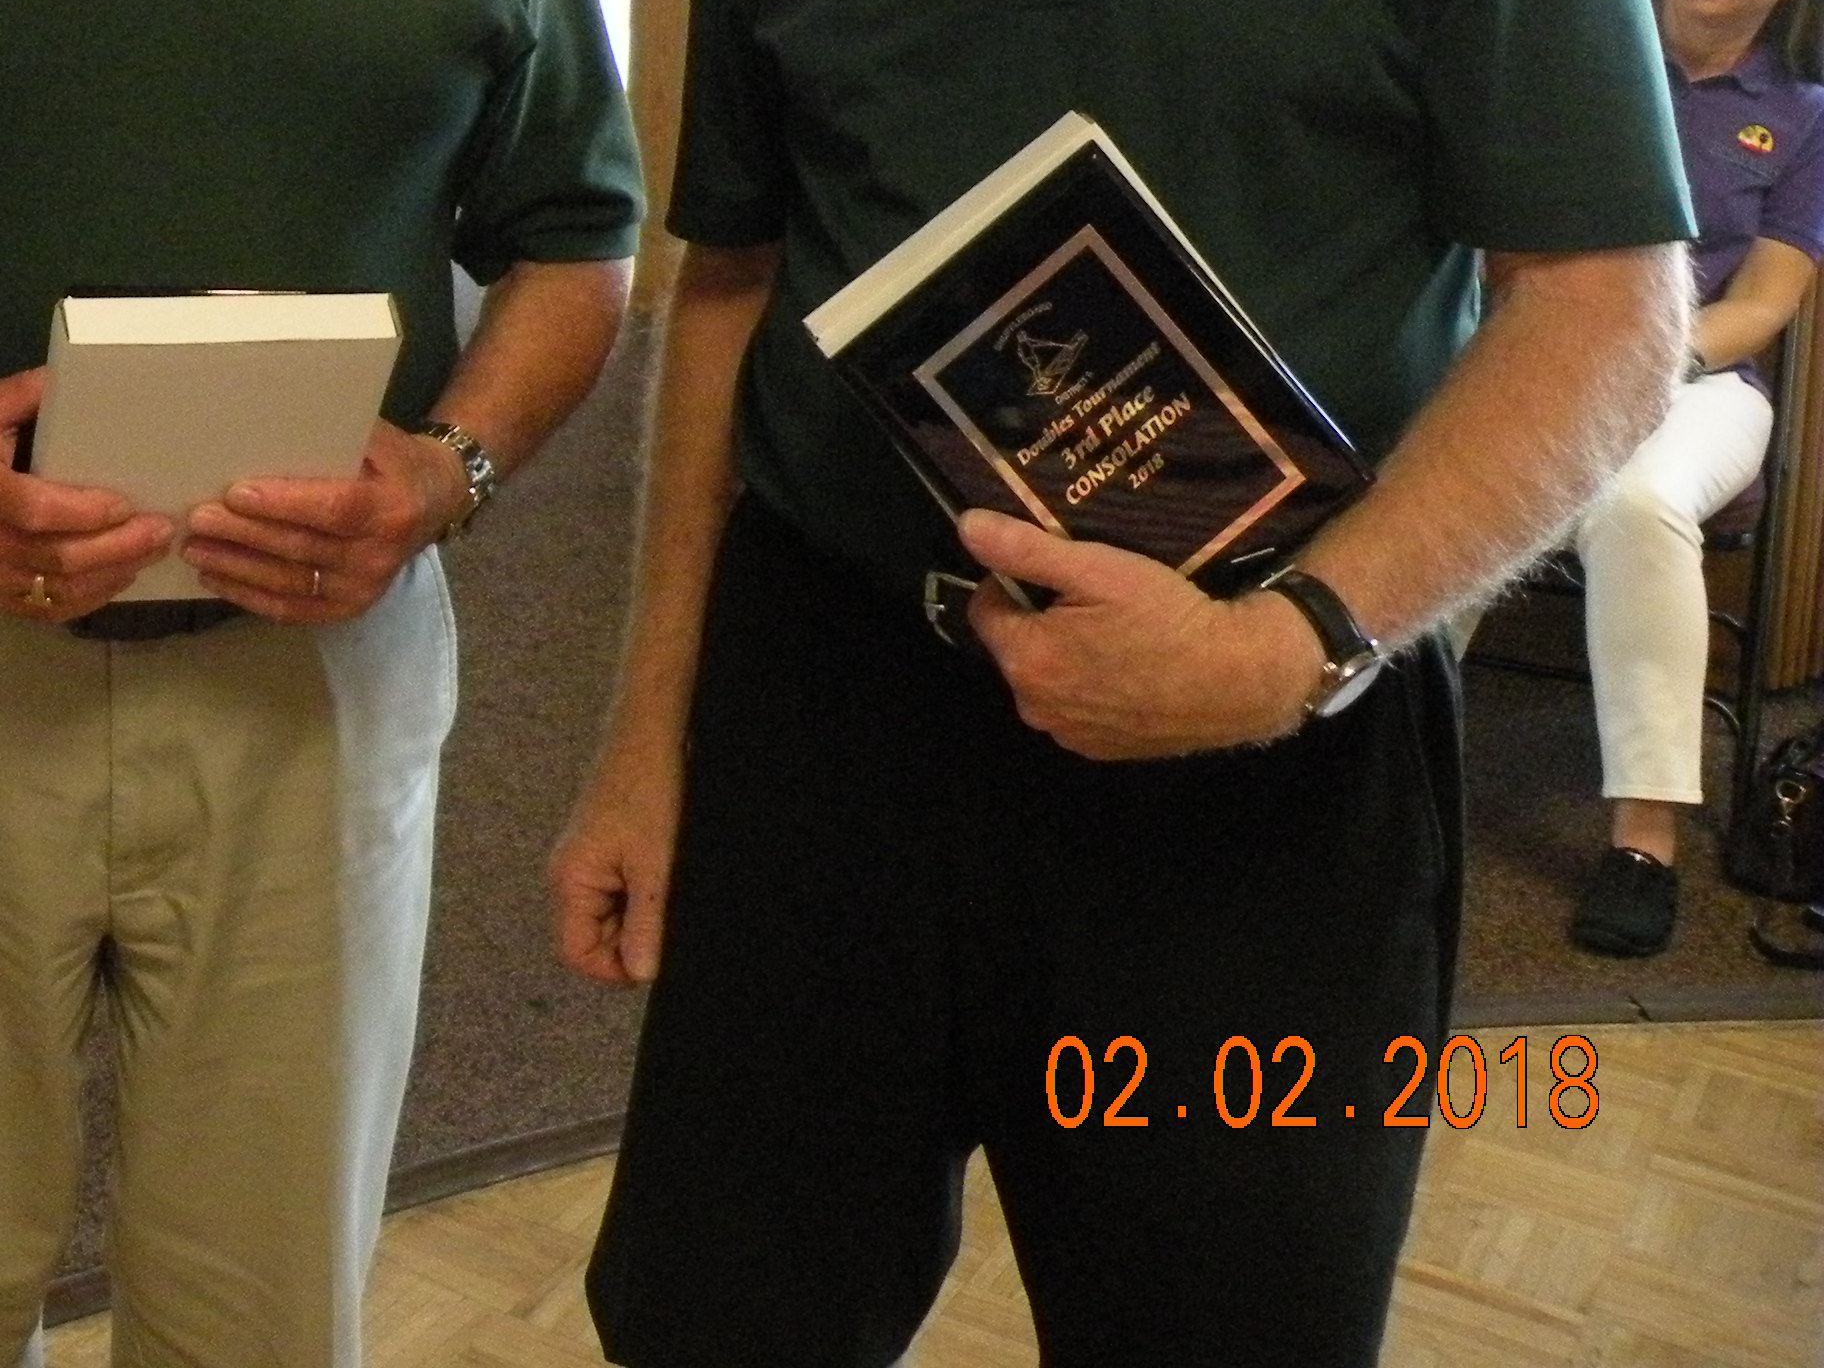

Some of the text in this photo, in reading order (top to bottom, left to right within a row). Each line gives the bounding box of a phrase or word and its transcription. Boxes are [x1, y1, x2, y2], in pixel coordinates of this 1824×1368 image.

[1016, 340, 1161, 466] Doubles Tournament
[1061, 385, 1155, 470] 3rd Place
[1066, 392, 1191, 505] CONSOLATION
[1128, 452, 1165, 489] 2018
